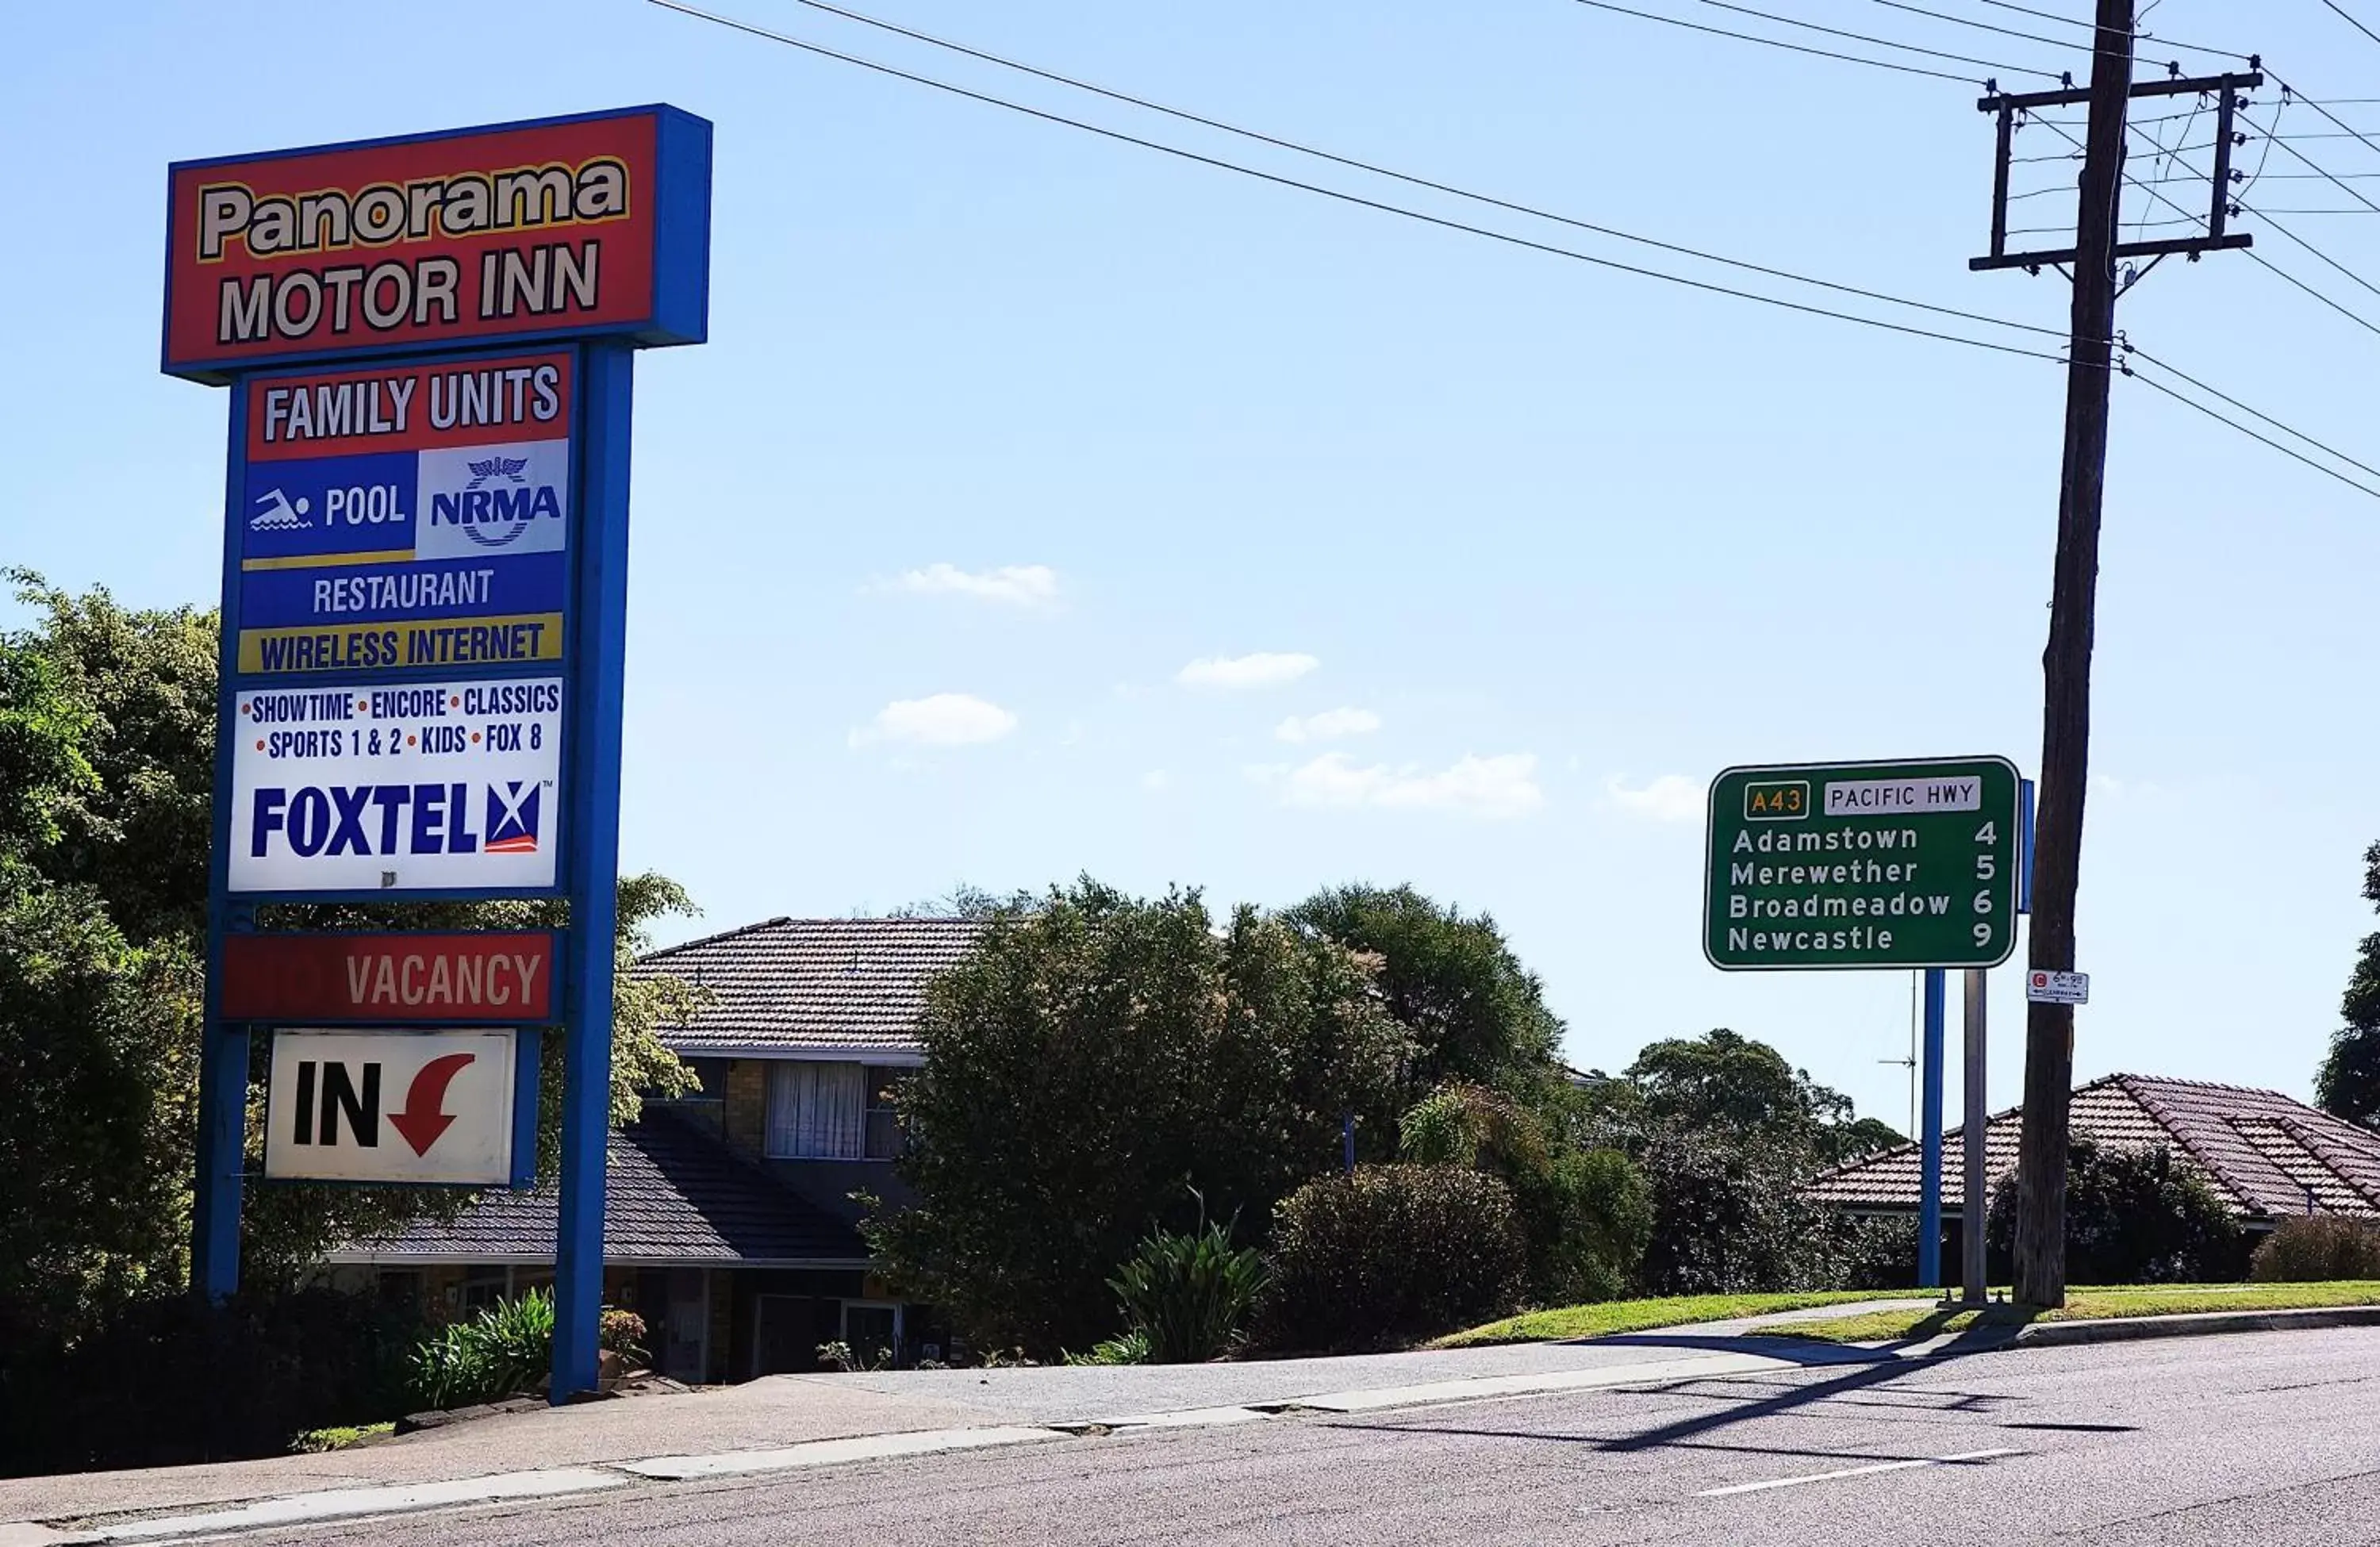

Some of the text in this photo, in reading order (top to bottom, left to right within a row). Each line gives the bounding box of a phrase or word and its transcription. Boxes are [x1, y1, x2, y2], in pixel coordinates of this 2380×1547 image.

[198, 156, 628, 262] Panorama
[217, 240, 601, 344] MOTOR INN
[264, 365, 559, 443] FAMILY UNITS
[325, 485, 405, 527] POOL
[431, 486, 561, 526] NRMA
[314, 570, 494, 613] RESTAURANT
[261, 623, 544, 670] WIRELESS INTERNET
[251, 685, 559, 724] SHOWTIME ENCORE CLASSICS
[268, 723, 541, 759] SPORTS 1 & 2 KIDS FOX 8
[1751, 783, 1974, 812] A43 PACIFIC HWY
[251, 782, 476, 858] FOXTEL
[1733, 821, 1997, 853] Adamstown 4
[1730, 854, 1995, 886] Merewether 5
[1729, 889, 1993, 918] Broadmeadow 6
[1728, 923, 1993, 951] Newcastle 9
[346, 954, 541, 1005] VACANCY
[294, 1061, 382, 1147] IN
